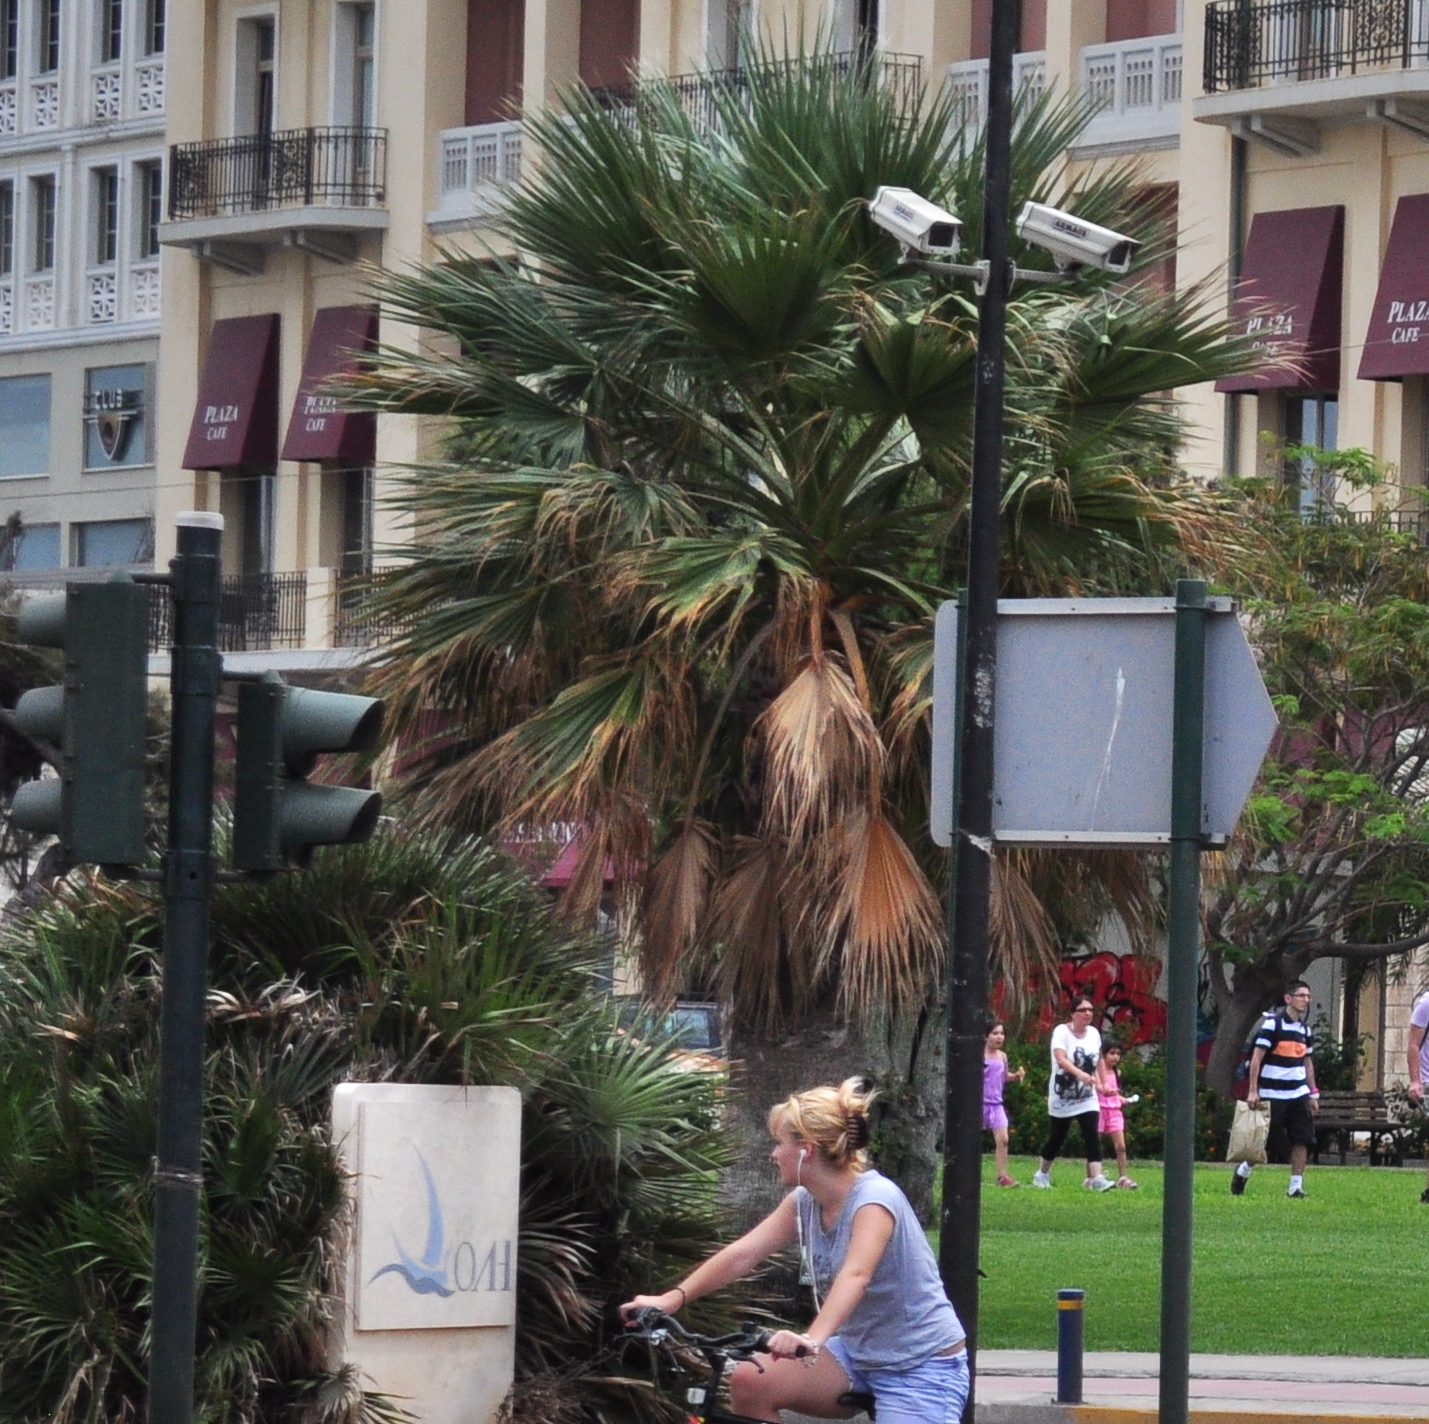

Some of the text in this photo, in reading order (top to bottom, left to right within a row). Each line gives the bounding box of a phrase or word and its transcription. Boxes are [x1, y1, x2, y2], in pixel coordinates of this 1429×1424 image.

[1391, 327, 1421, 344] CAFE
[204, 405, 239, 424] PLAZA
[206, 426, 229, 441] CAFE
